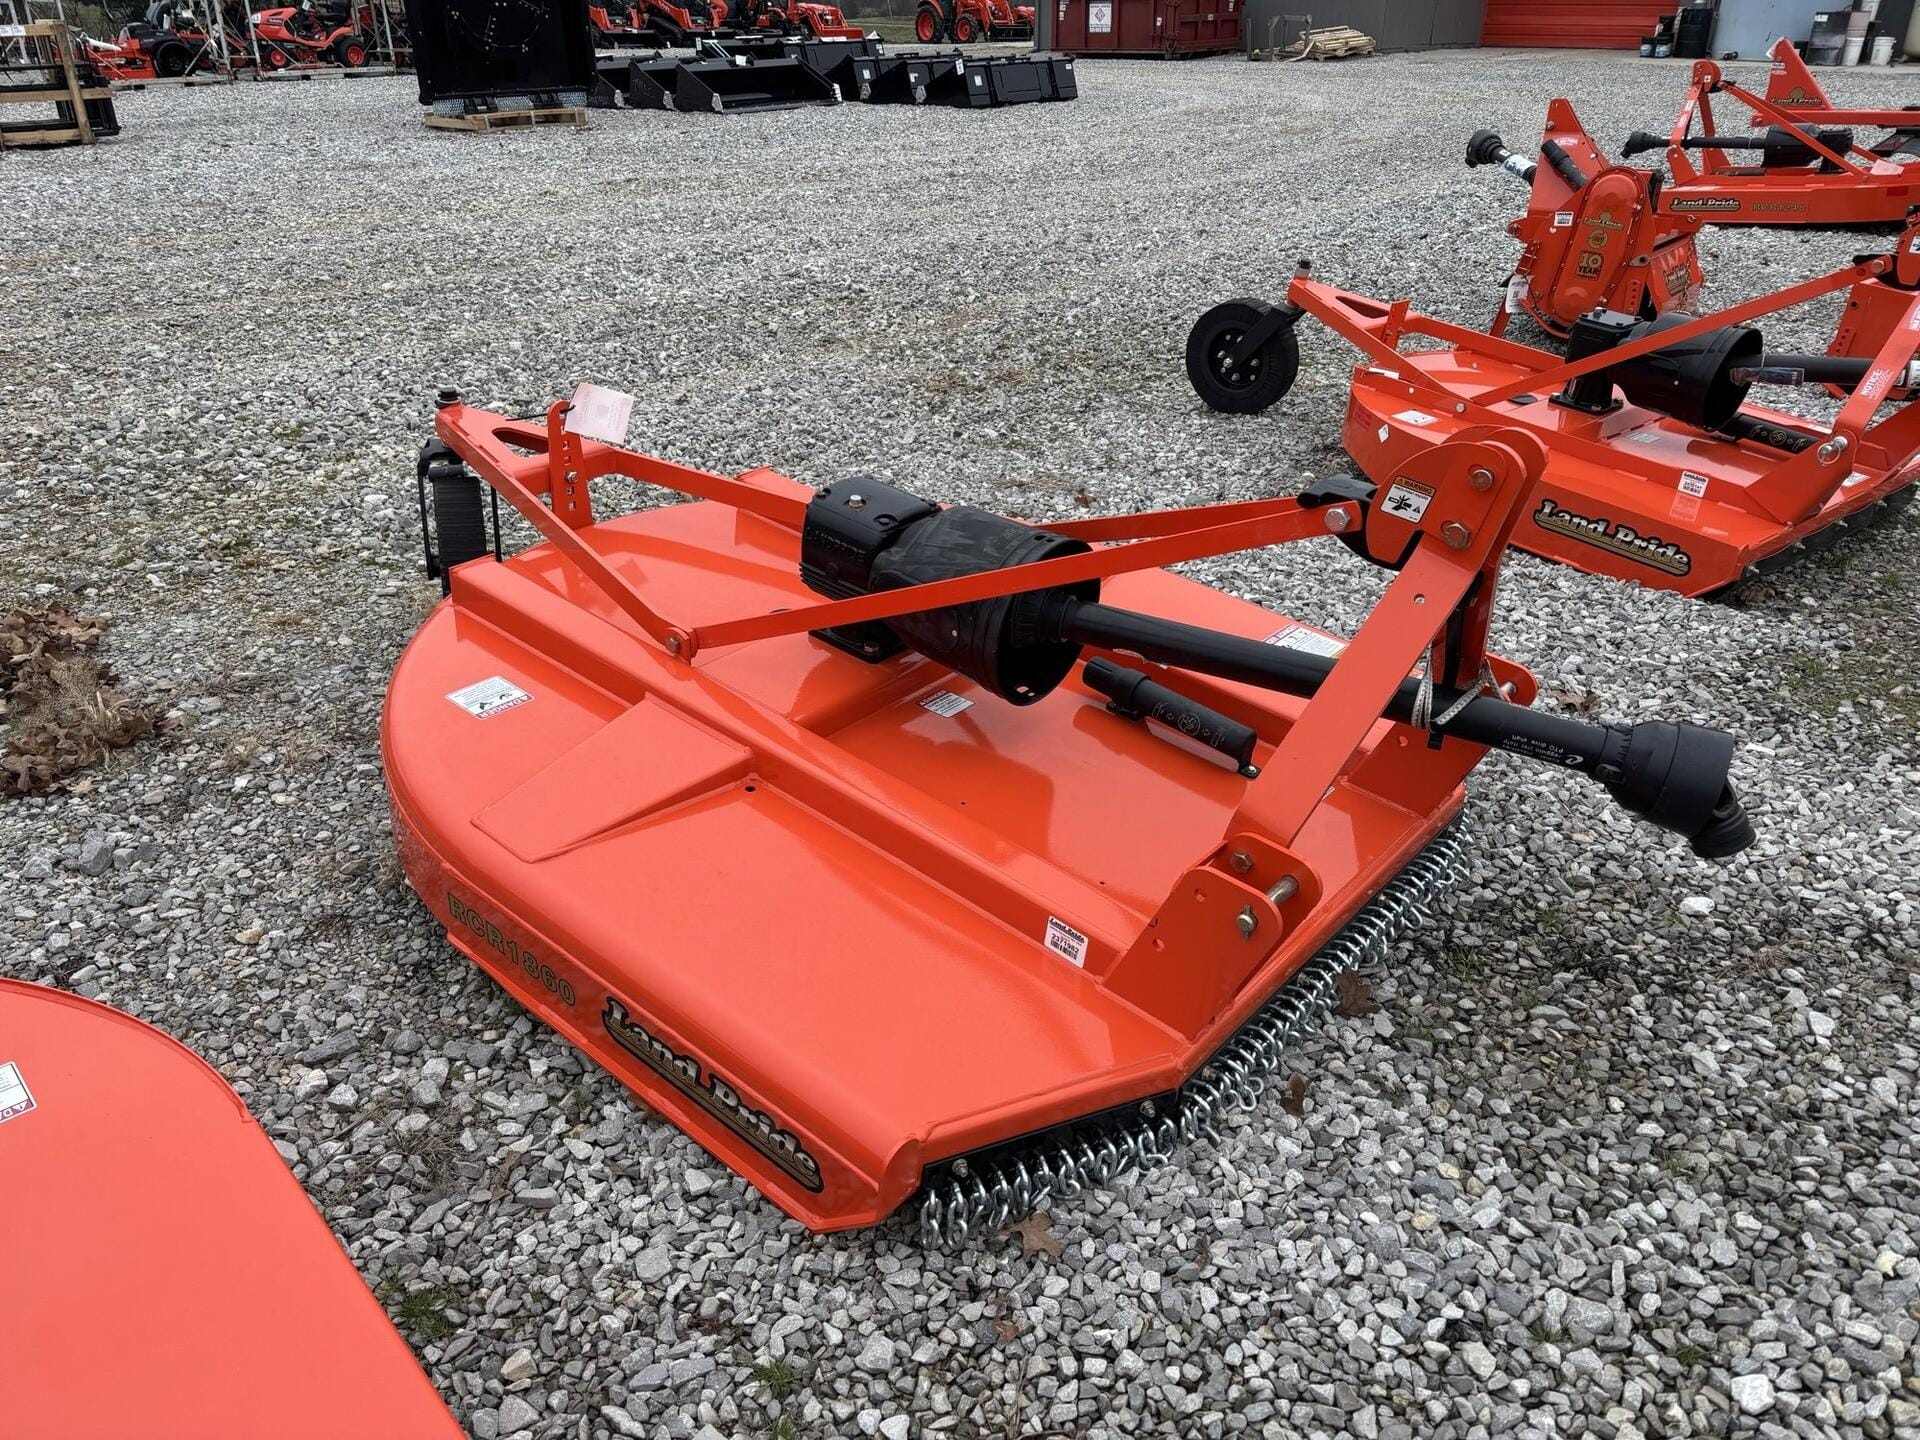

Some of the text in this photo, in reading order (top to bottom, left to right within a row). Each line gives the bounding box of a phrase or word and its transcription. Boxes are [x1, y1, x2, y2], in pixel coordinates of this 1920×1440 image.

[1672, 198, 1739, 208] Land Pride
[1580, 252, 1603, 268] 10
[1578, 266, 1600, 276] YEAR
[1860, 368, 1883, 396] NOTICE
[1404, 480, 1433, 495] WARNING
[1537, 500, 1689, 568] Land Pride
[479, 698, 522, 718] DANGER
[1511, 734, 1564, 753] PTO drive shaft
[1049, 917, 1067, 931] Land
[1067, 927, 1085, 943] Pride
[448, 893, 576, 1007] RCR1860
[605, 997, 820, 1178] Land Pride
